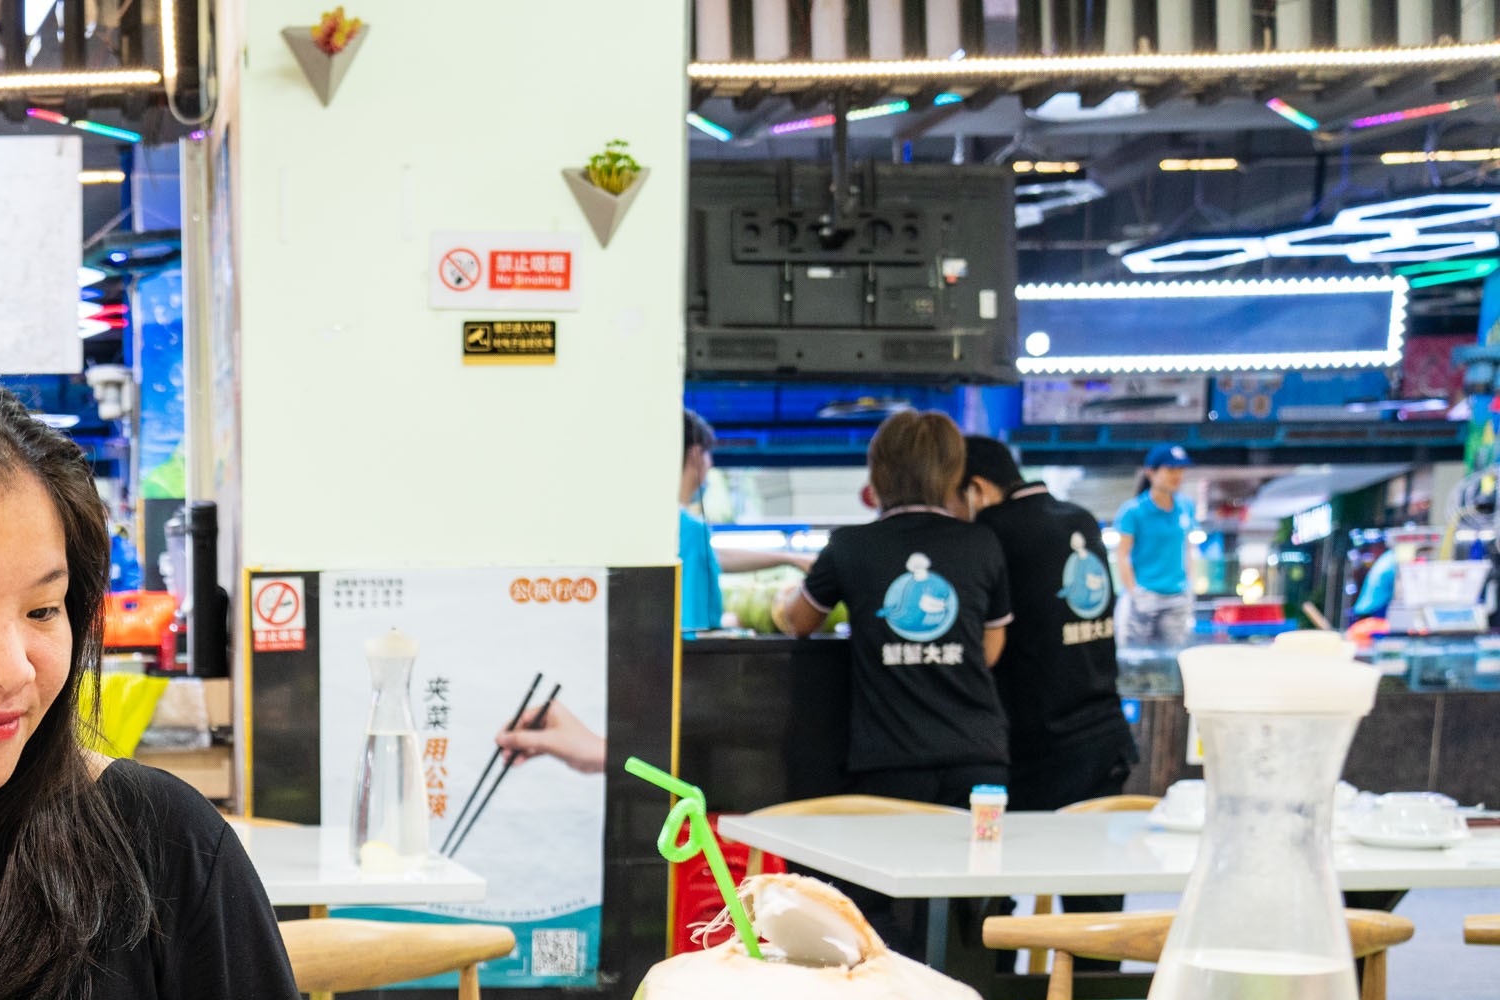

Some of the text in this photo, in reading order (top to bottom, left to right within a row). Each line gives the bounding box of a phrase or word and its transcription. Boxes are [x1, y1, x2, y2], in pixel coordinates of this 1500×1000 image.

[496, 254, 566, 272] 禁止吸烟
[496, 274, 564, 288] No Smoking
